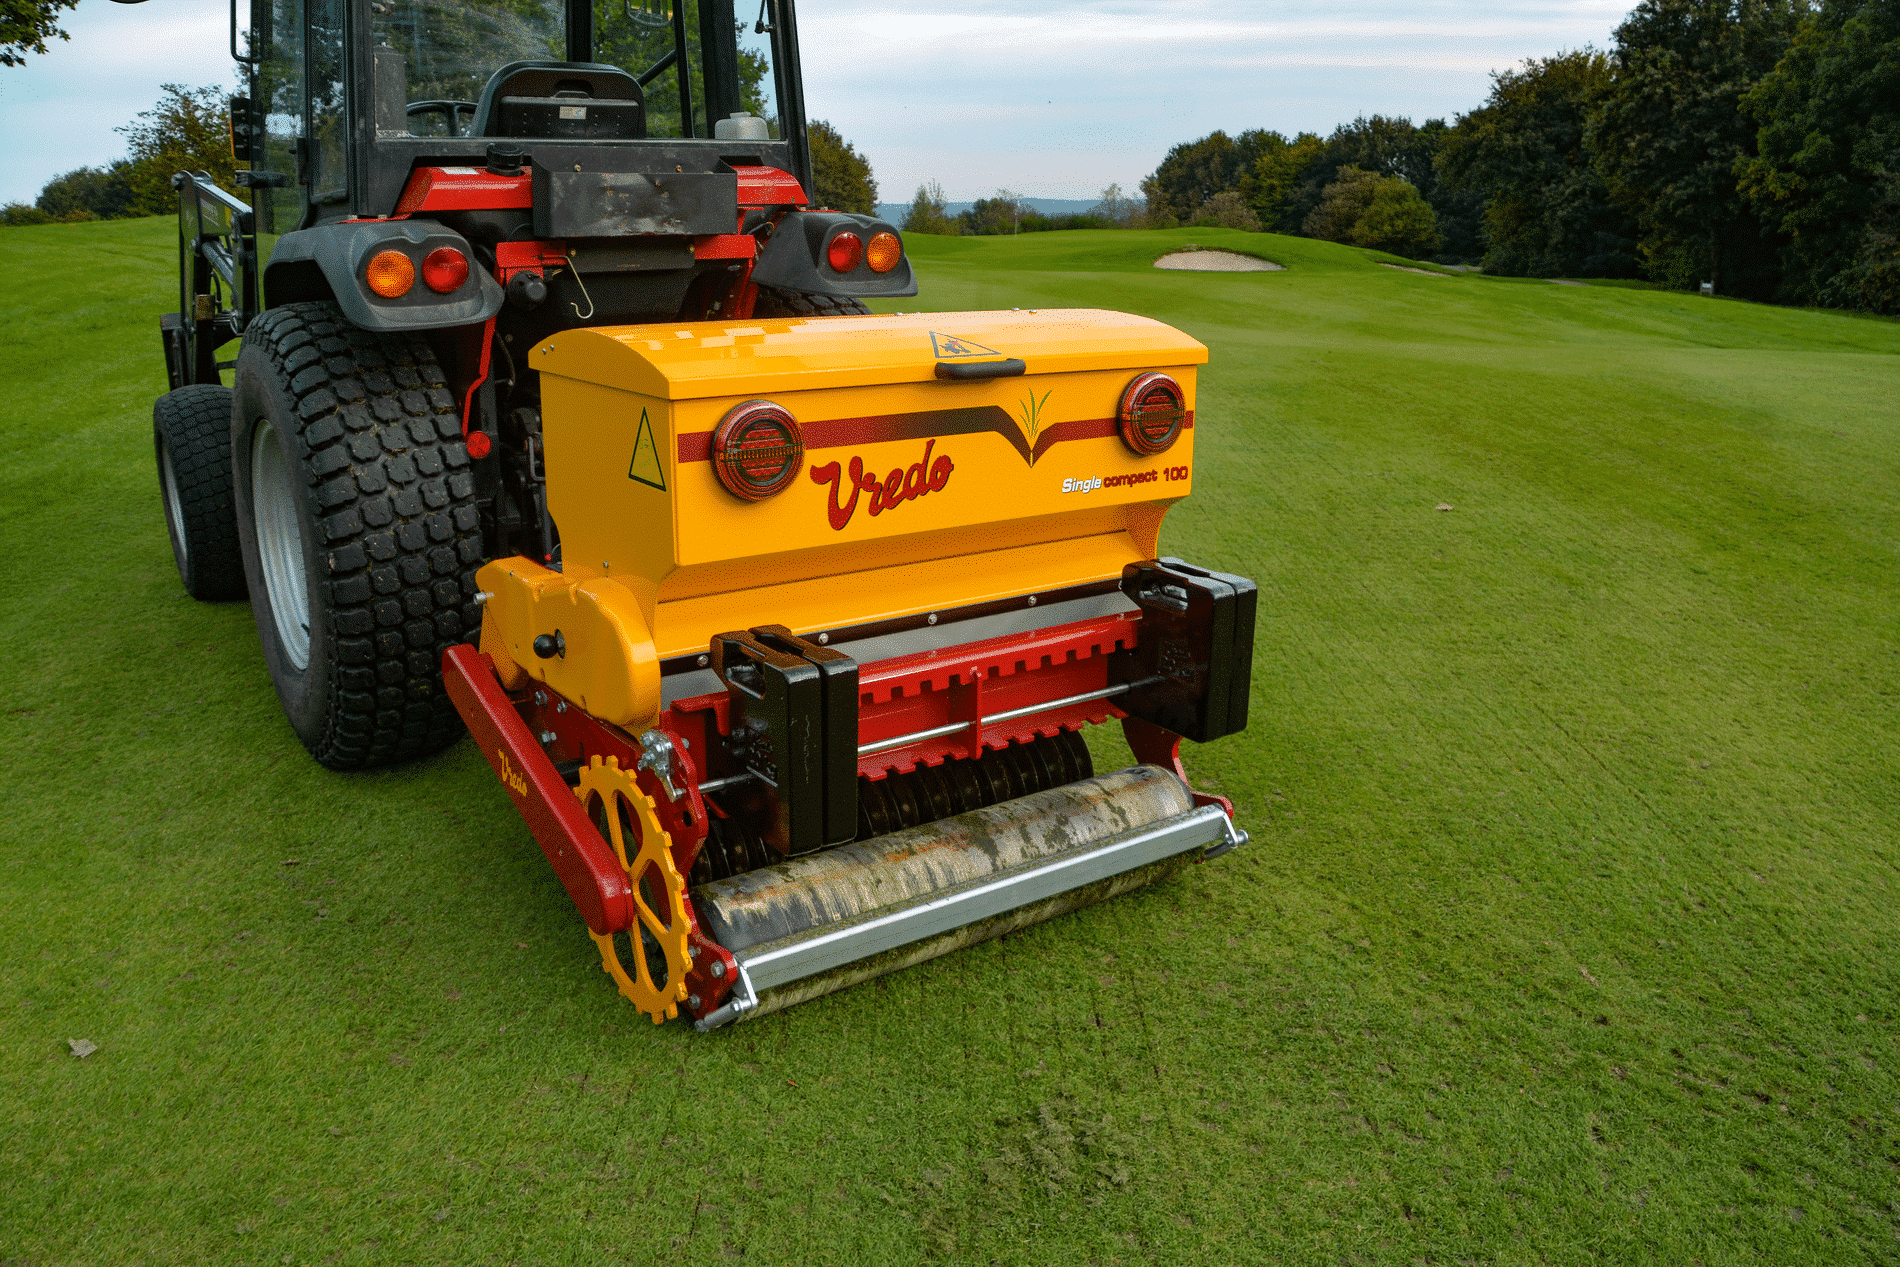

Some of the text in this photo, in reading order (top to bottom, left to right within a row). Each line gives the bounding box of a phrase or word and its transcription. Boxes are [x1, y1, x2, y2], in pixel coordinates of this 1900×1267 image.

[809, 438, 954, 531] Vredo
[1062, 465, 1188, 493] Single compact 100
[498, 749, 528, 797] Vredo
